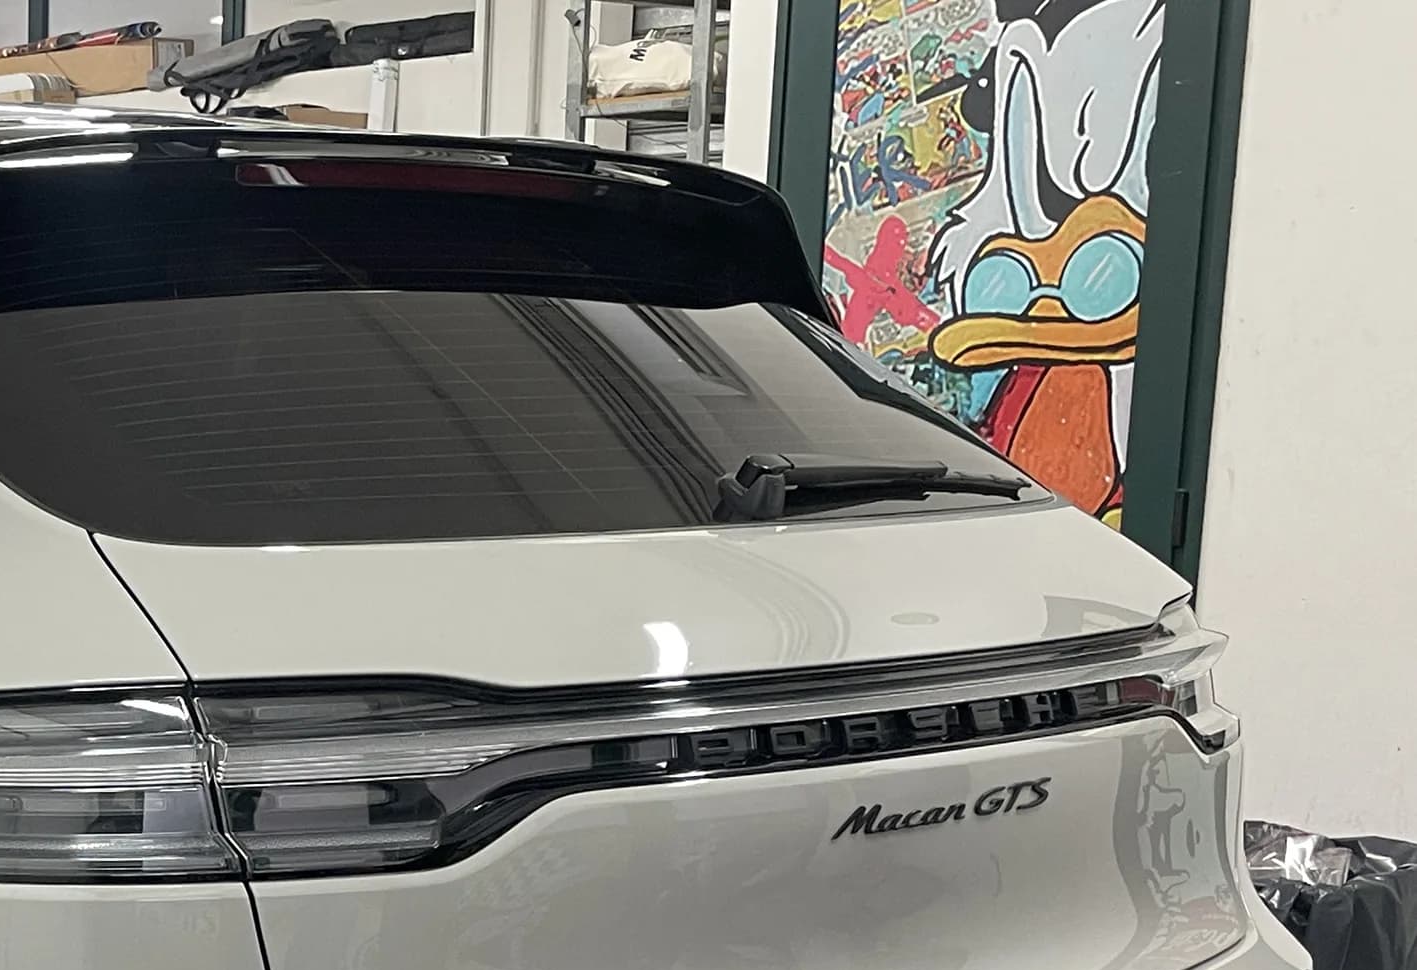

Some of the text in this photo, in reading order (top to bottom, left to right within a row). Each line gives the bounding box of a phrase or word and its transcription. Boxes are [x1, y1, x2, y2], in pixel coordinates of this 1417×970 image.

[690, 687, 1101, 767] PORSCHE
[831, 777, 1052, 841] Macan GTS
